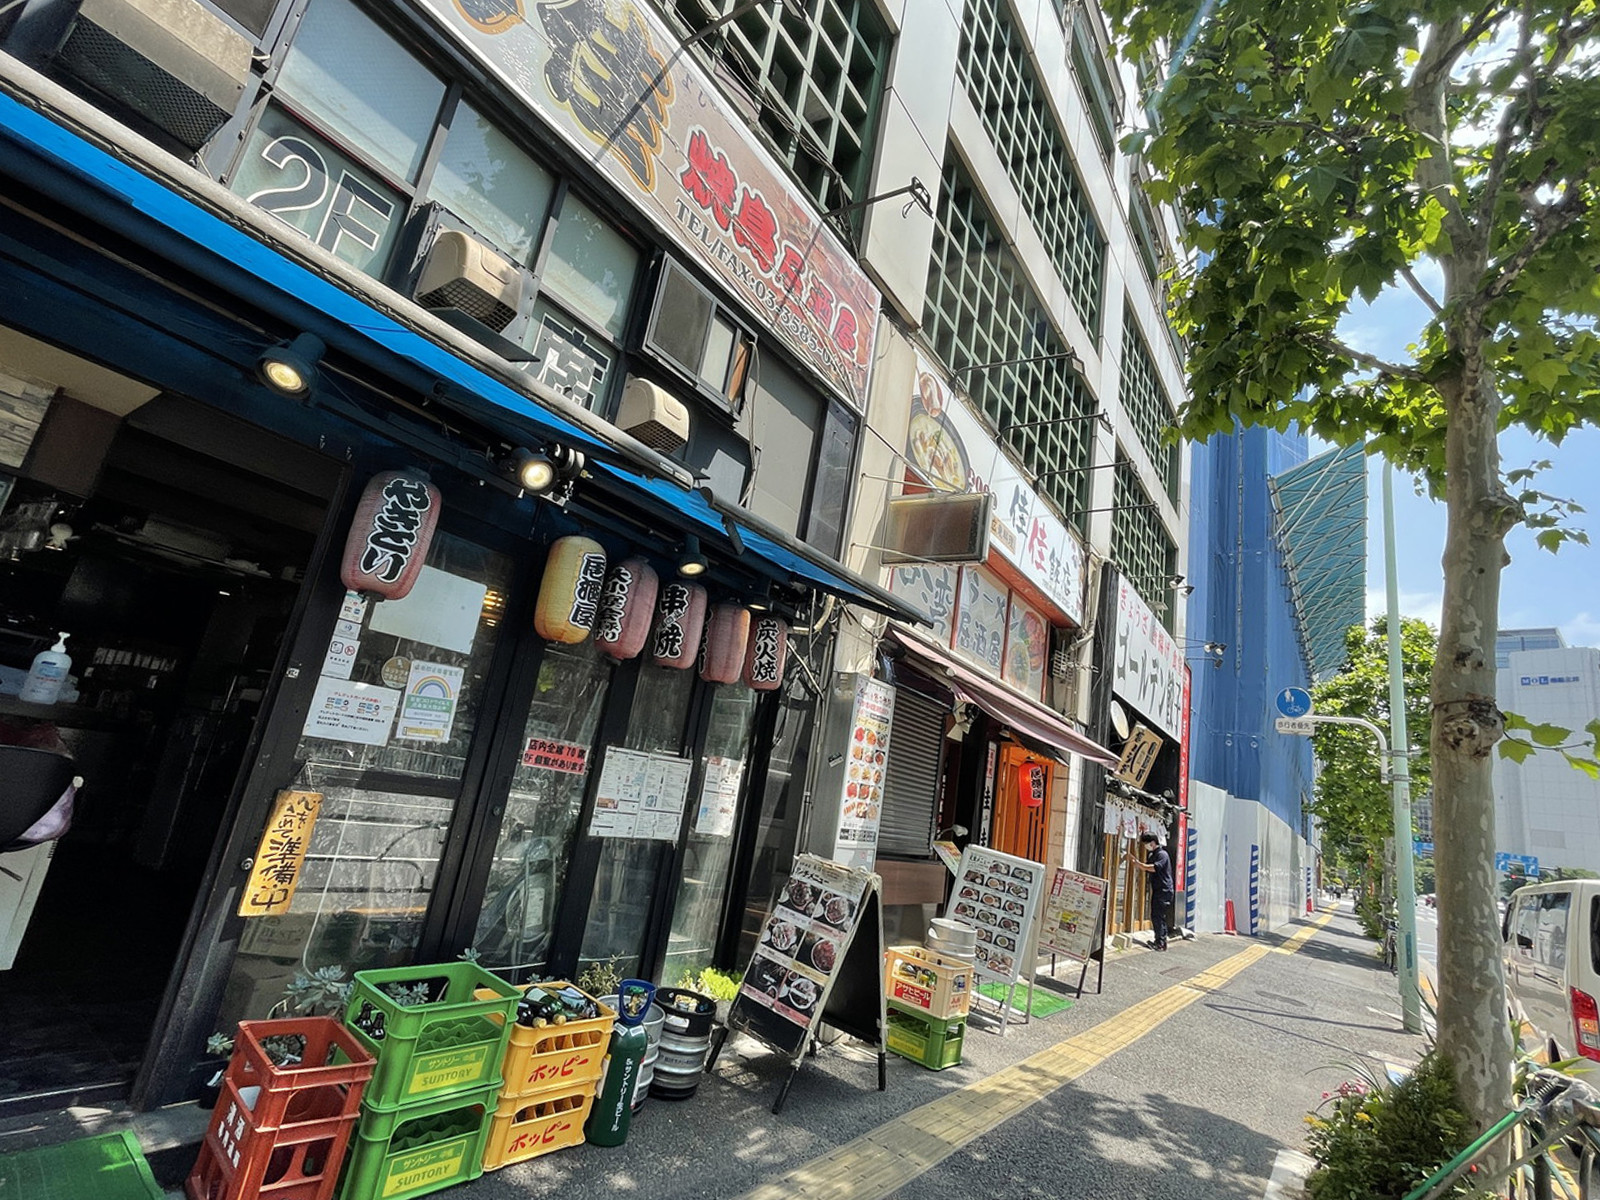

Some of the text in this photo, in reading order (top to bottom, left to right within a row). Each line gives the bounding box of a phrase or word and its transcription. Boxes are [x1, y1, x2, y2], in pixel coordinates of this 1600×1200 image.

[246, 136, 395, 254] 2F
[360, 478, 431, 583] やきとり
[569, 553, 607, 631] 居酒屋
[654, 584, 689, 658] 串焼
[752, 618, 779, 682] 炭火焼
[1521, 676, 1549, 686] MOL
[896, 982, 931, 1001] アサヒビール
[422, 1068, 473, 1087] SUNTORY
[528, 1055, 589, 1082] ホッピー
[508, 1121, 571, 1153] ホッピー
[396, 1164, 451, 1190] SUNTORY
